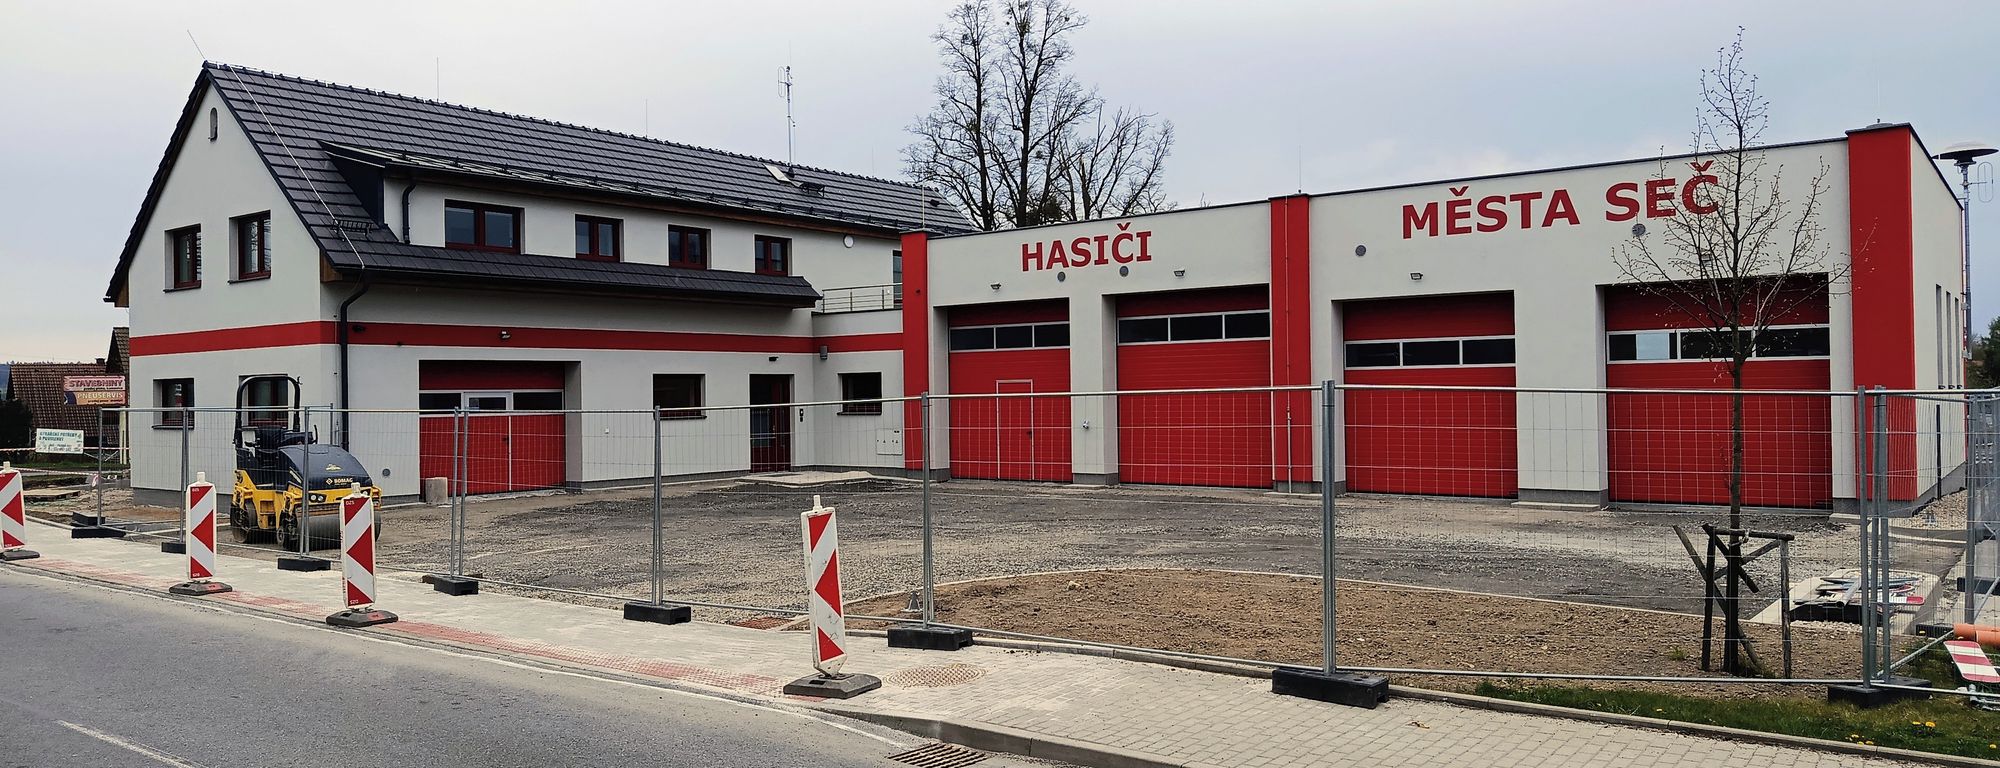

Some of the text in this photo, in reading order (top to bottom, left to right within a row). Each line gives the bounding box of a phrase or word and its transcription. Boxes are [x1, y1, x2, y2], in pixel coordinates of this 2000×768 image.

[1022, 160, 1719, 272] HASIČI MĚSTA SEČ
